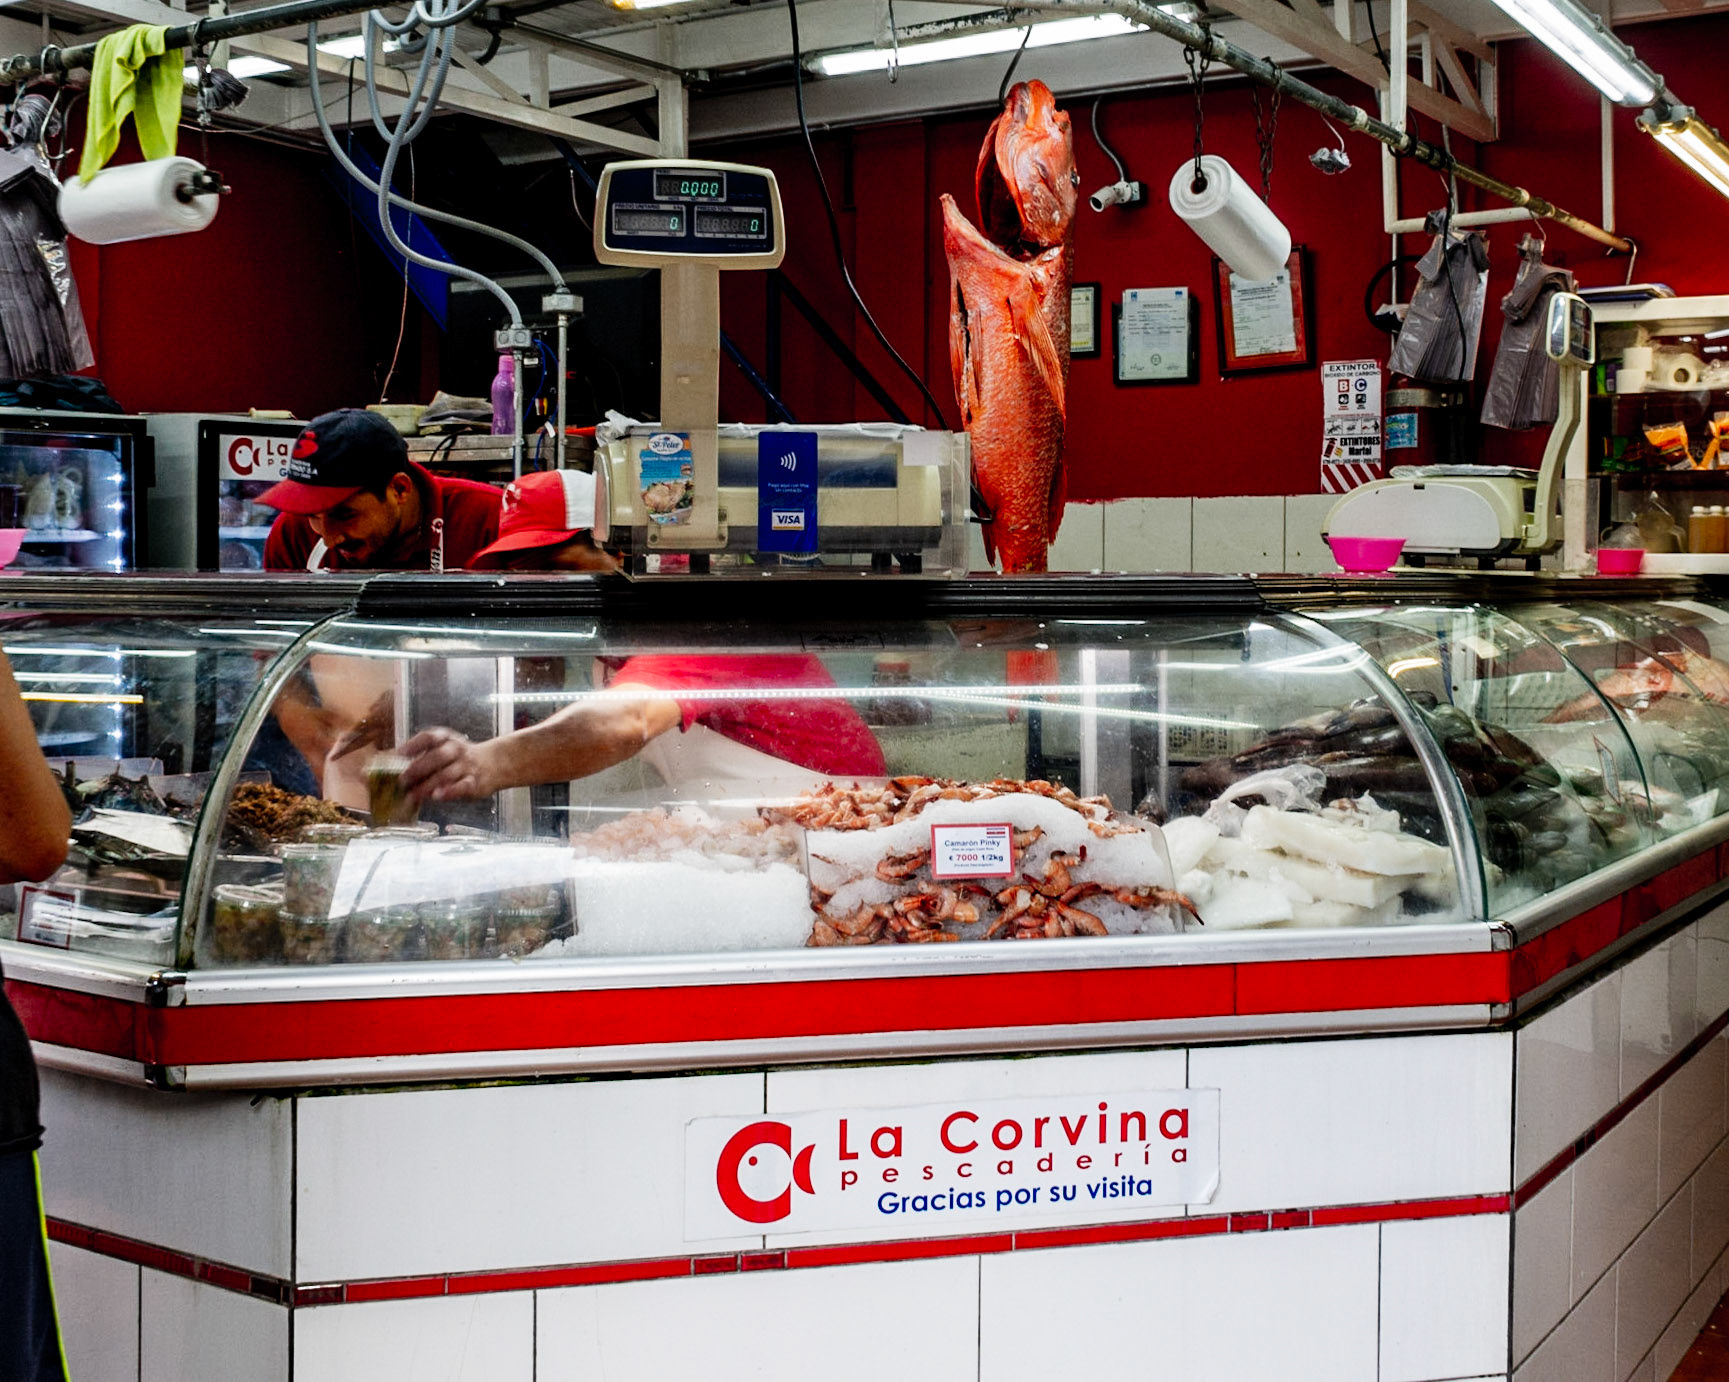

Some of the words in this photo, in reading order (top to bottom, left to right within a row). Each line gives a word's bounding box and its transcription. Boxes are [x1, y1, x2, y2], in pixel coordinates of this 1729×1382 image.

[1330, 364, 1376, 373] EXTINTOR
[1340, 437, 1381, 446] EXTINTORES
[267, 439, 288, 456] La
[776, 514, 801, 524] VISA
[980, 839, 1001, 847] Pinky
[982, 854, 1004, 862] 1/2kg
[839, 1118, 903, 1161] La
[940, 1101, 1189, 1155] Corvina
[841, 1148, 1187, 1191] pescadería
[878, 1187, 986, 1216] Gracias
[997, 1187, 1041, 1213] por
[1050, 1185, 1077, 1203] su
[1088, 1175, 1153, 1200] visita
